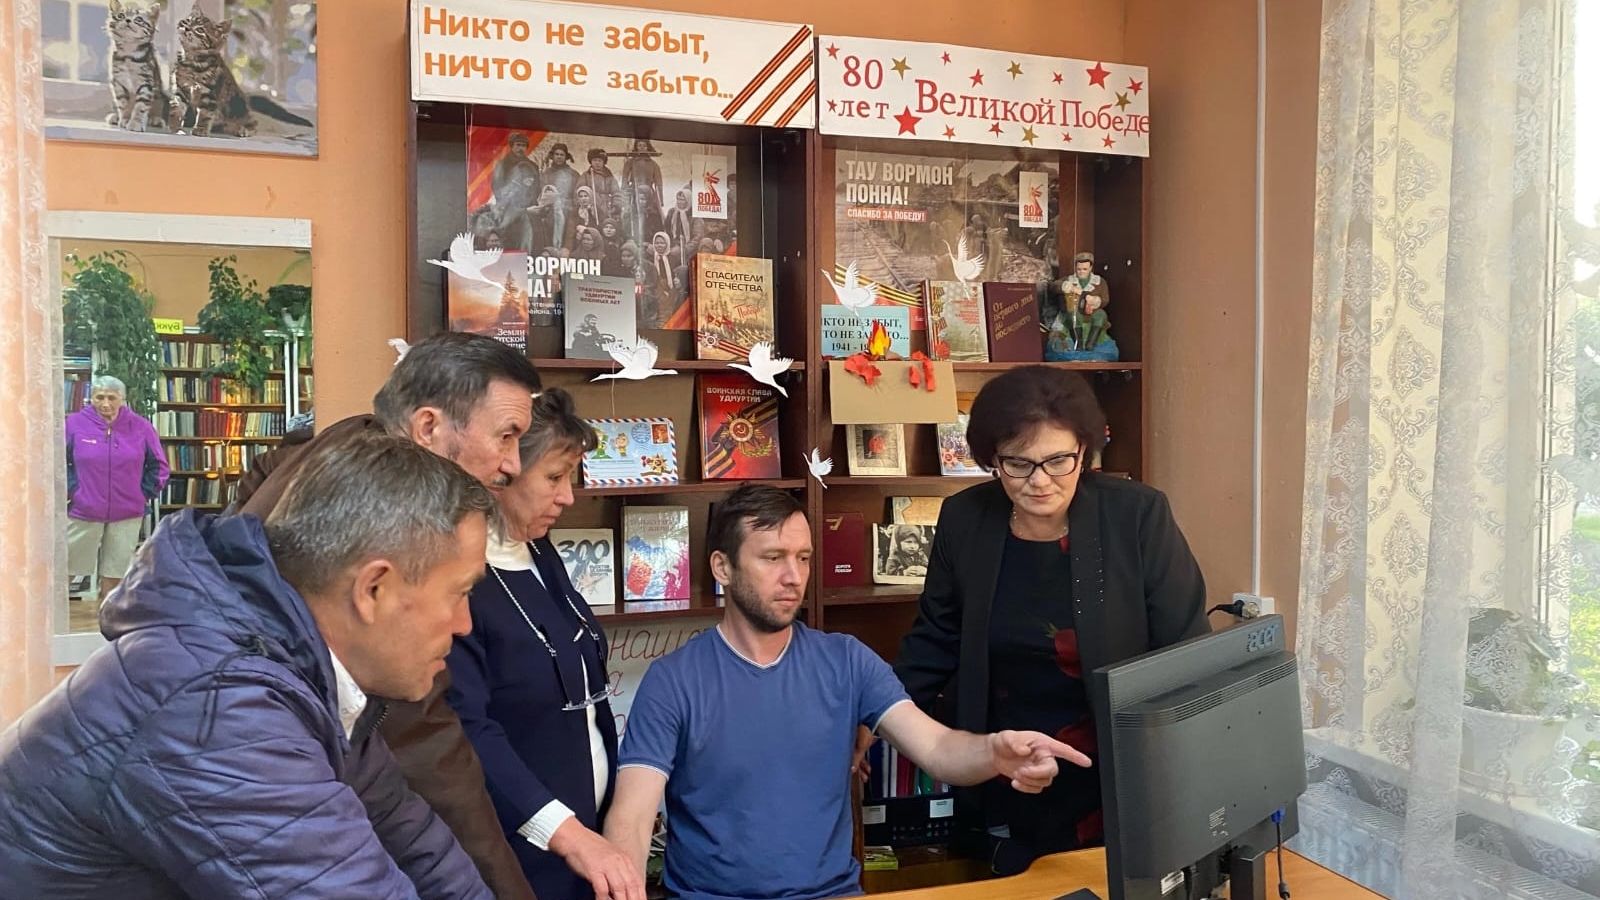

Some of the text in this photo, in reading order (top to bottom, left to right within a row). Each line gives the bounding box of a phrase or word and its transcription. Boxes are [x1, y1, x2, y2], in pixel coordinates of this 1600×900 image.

[423, 6, 709, 63] Никто не забыт,
[424, 52, 734, 99] ничто не забыто...
[842, 55, 884, 90] 80
[838, 99, 890, 120] лет
[915, 79, 1150, 137] Великой Победе
[846, 160, 953, 186] ТАУ ВОРМОН
[846, 183, 909, 205] ПОННА!
[847, 208, 925, 222] СПАСИБО ЗА ПОБЕДУ!
[527, 255, 600, 276] ВОРМОН
[705, 270, 763, 283] СПАСИТЕЛИ
[705, 280, 763, 292] ОТЕЧЕСТВА
[822, 317, 845, 327] КТО
[864, 318, 902, 328] ЗБЫТ,
[840, 331, 854, 339] НЕ
[832, 343, 850, 351] 1941
[557, 539, 610, 564] 300
